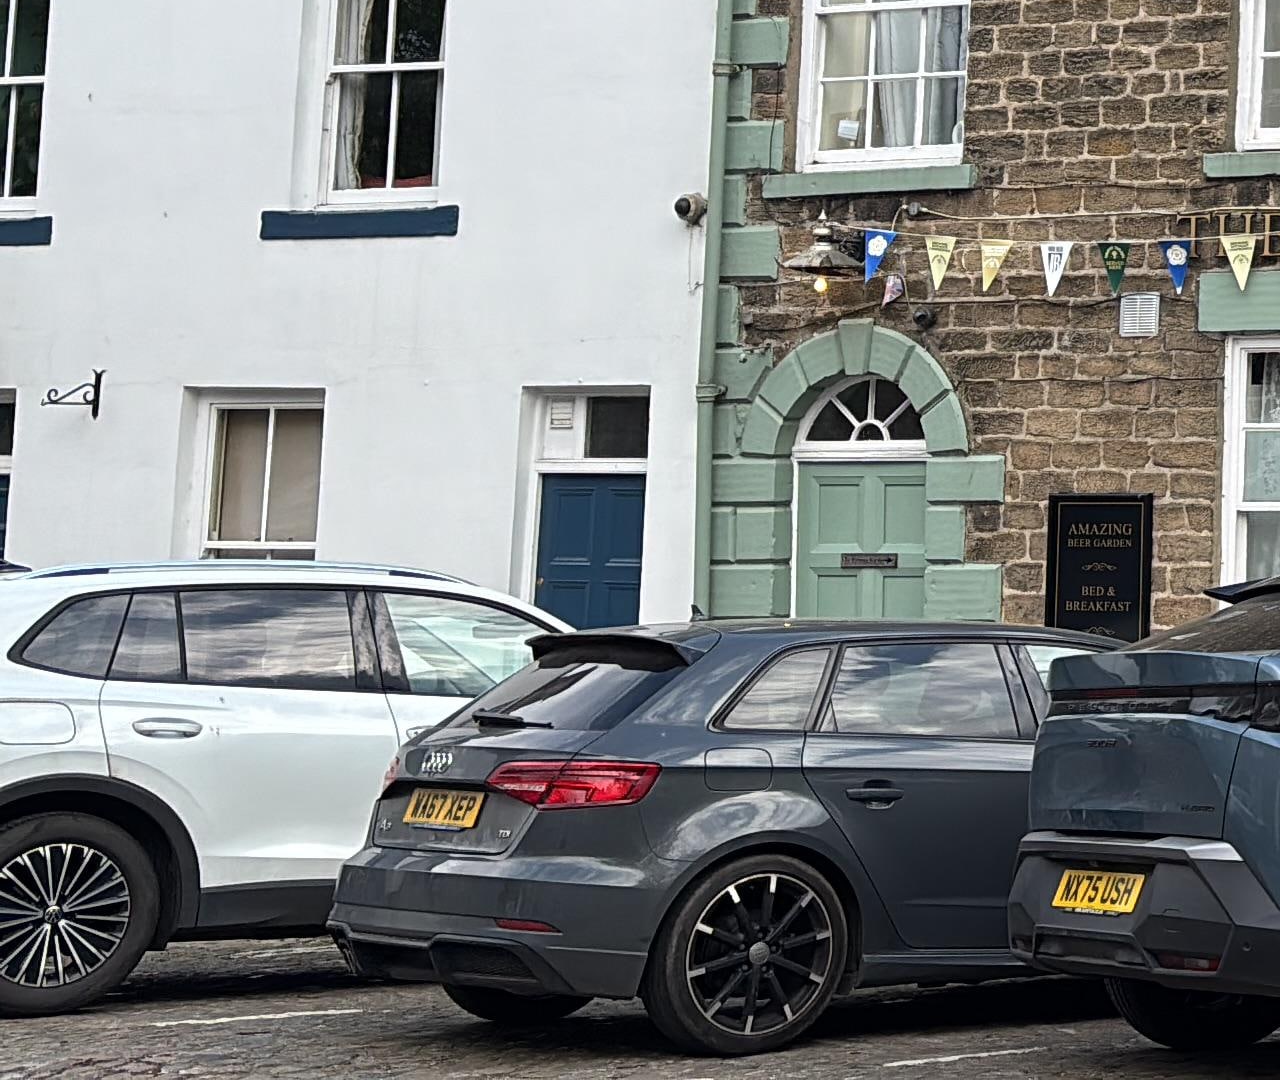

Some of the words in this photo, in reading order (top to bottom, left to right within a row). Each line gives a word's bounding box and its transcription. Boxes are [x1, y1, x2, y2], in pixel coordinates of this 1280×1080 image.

[1068, 523, 1132, 535] AMAZING
[1067, 539, 1091, 547] BEER
[1093, 539, 1132, 548] GARDEN
[1081, 586, 1105, 596] BED
[1107, 586, 1116, 596] &
[1065, 601, 1132, 612] BREAKFAST
[410, 792, 447, 820] WA67
[443, 794, 477, 821] XEP
[1060, 874, 1104, 903] NX75
[1100, 876, 1137, 907] USH
